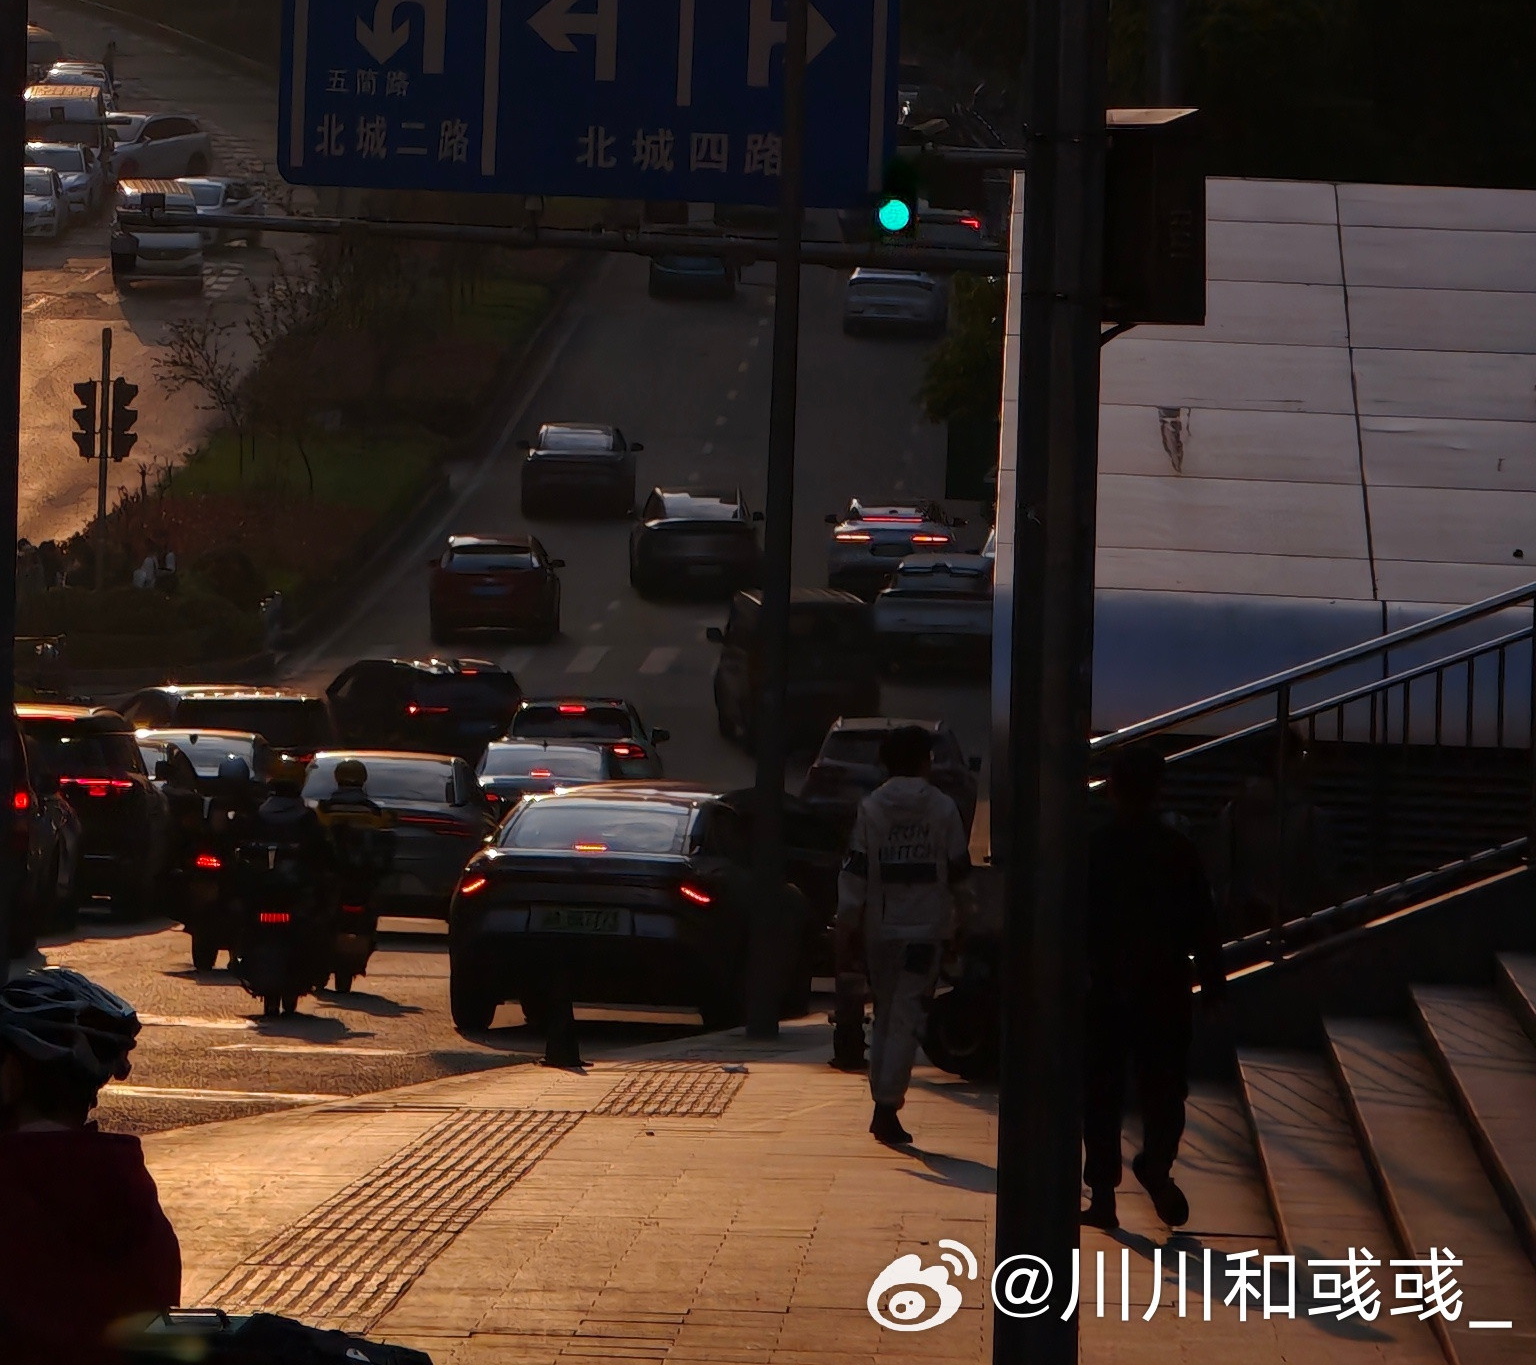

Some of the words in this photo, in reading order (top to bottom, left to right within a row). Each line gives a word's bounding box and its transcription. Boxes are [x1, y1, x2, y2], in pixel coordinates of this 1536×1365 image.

[314, 113, 470, 163] 北城二路
[576, 126, 783, 177] 北城四路
